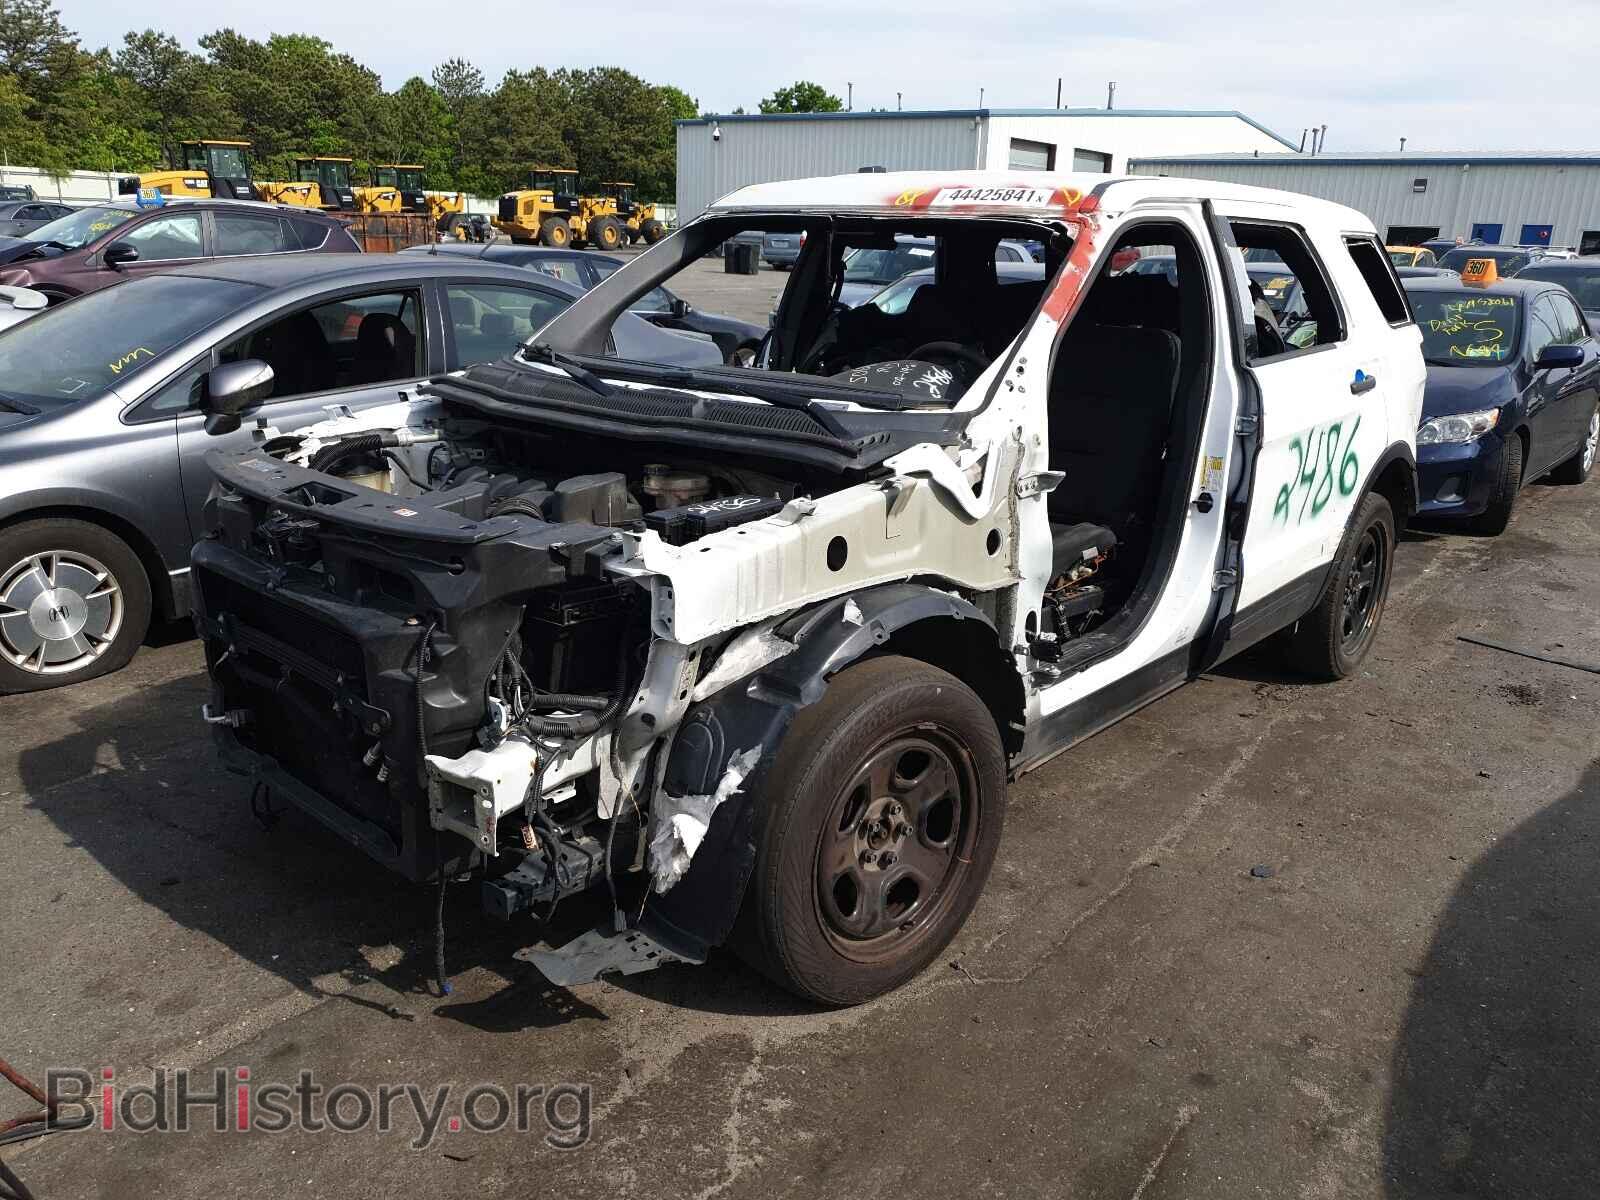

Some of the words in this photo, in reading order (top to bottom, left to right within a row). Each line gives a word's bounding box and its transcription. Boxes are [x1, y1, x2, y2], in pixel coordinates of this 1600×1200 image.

[949, 188, 1036, 203] 44425841
[1466, 260, 1486, 275] 360
[1271, 414, 1362, 527] 2486
